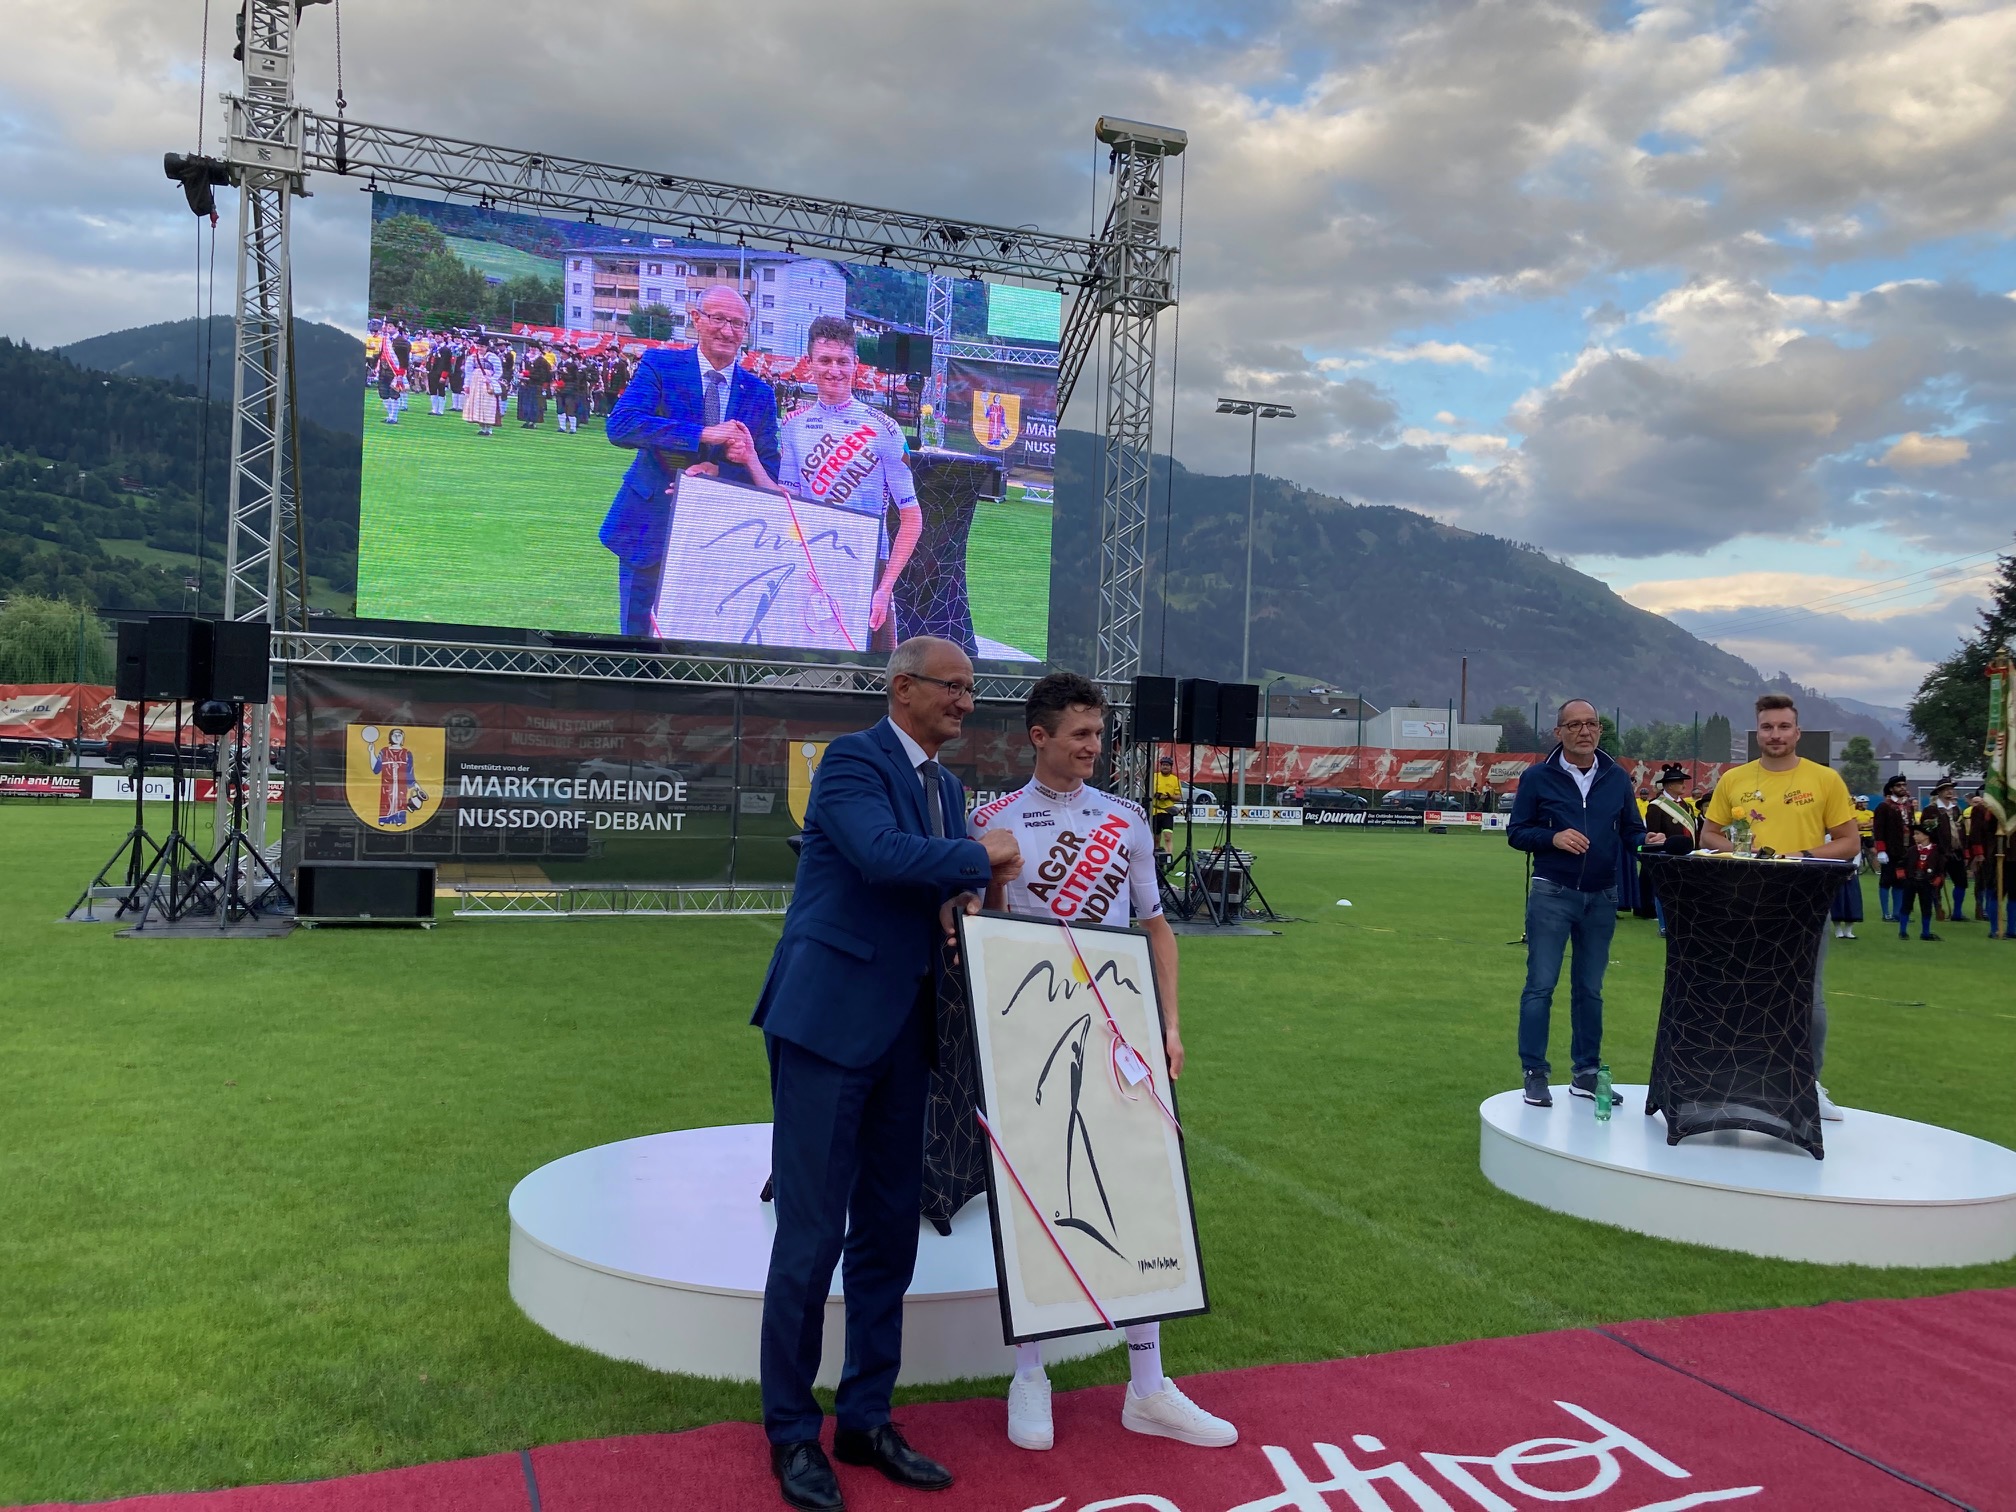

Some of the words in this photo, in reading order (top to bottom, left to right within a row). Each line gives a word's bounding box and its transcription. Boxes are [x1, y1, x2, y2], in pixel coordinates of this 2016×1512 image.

[800, 433, 840, 483] AG2R
[32, 704, 51, 712] IDL
[460, 763, 502, 772] Unterstützt
[517, 764, 530, 772] der
[0, 774, 26, 785] Print
[27, 775, 50, 786] and
[51, 776, 81, 786] More
[117, 780, 164, 794] leon
[459, 775, 688, 802] MARKTGEMEINDE
[1795, 797, 1815, 806] TEAM
[458, 808, 687, 831] NUSSDORF-DEBANT
[1022, 809, 1051, 819] BMC
[1305, 812, 1319, 820] Das
[1315, 810, 1367, 824] Journal
[1027, 830, 1087, 903] AG2R
[1051, 813, 1131, 917] CITROËN
